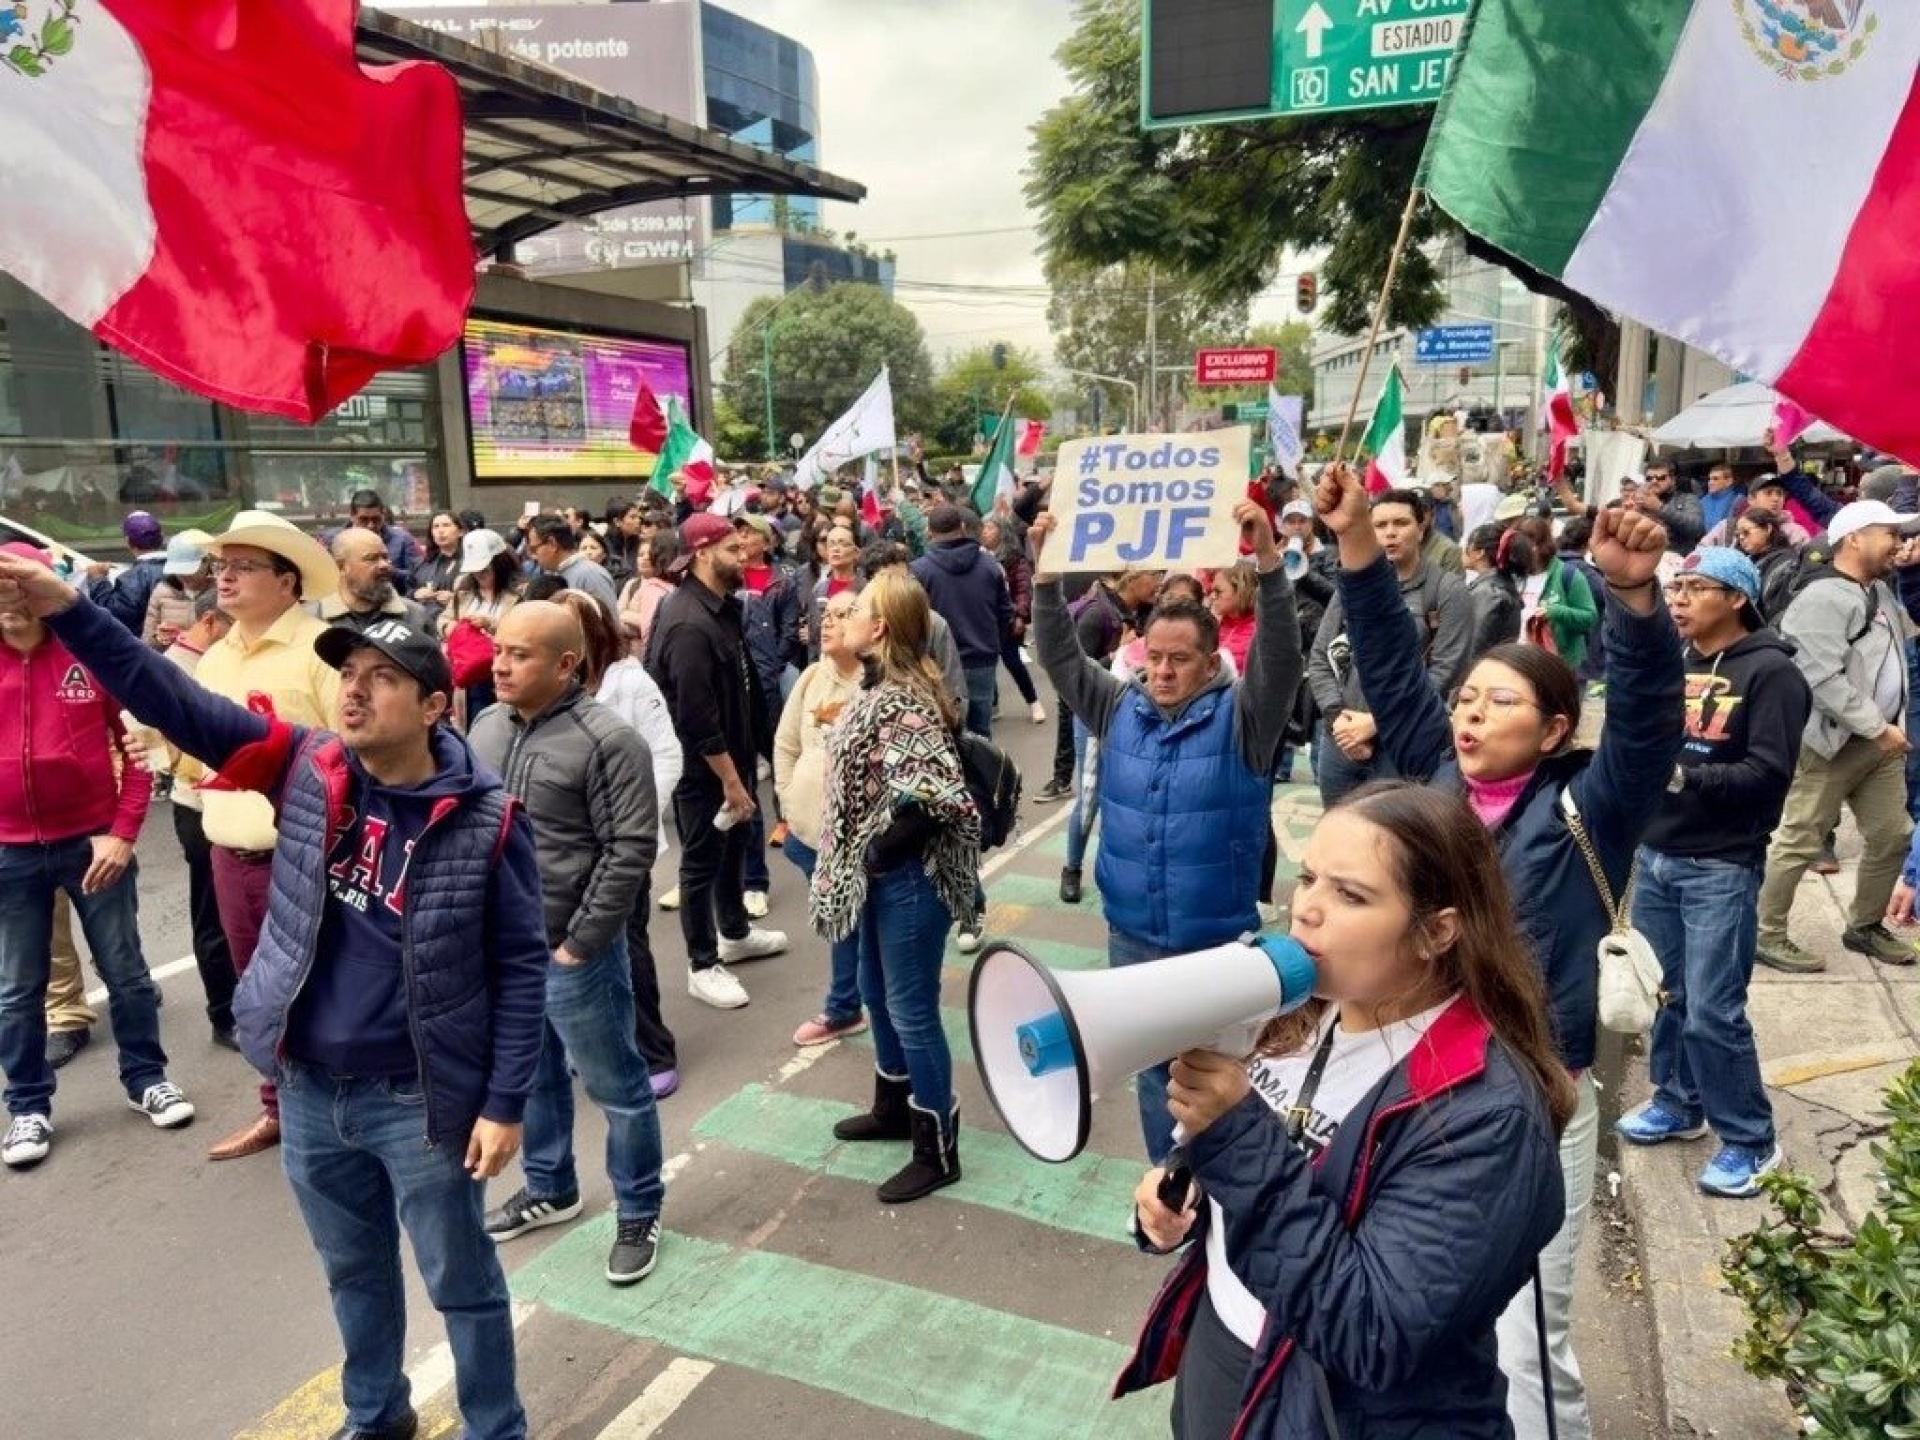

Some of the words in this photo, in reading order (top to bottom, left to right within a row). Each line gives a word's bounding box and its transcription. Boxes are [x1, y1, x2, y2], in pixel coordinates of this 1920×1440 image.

[547, 36, 629, 62] potente
[1383, 19, 1452, 51] ESTADIO
[1347, 62, 1400, 98] SAN
[623, 240, 693, 258] GWM
[1205, 353, 1269, 367] EXCLUSIVO
[1205, 367, 1267, 380] METROBUS
[1079, 442, 1220, 475] #Todos
[1077, 477, 1215, 508] Somos
[1068, 506, 1211, 563] PJF
